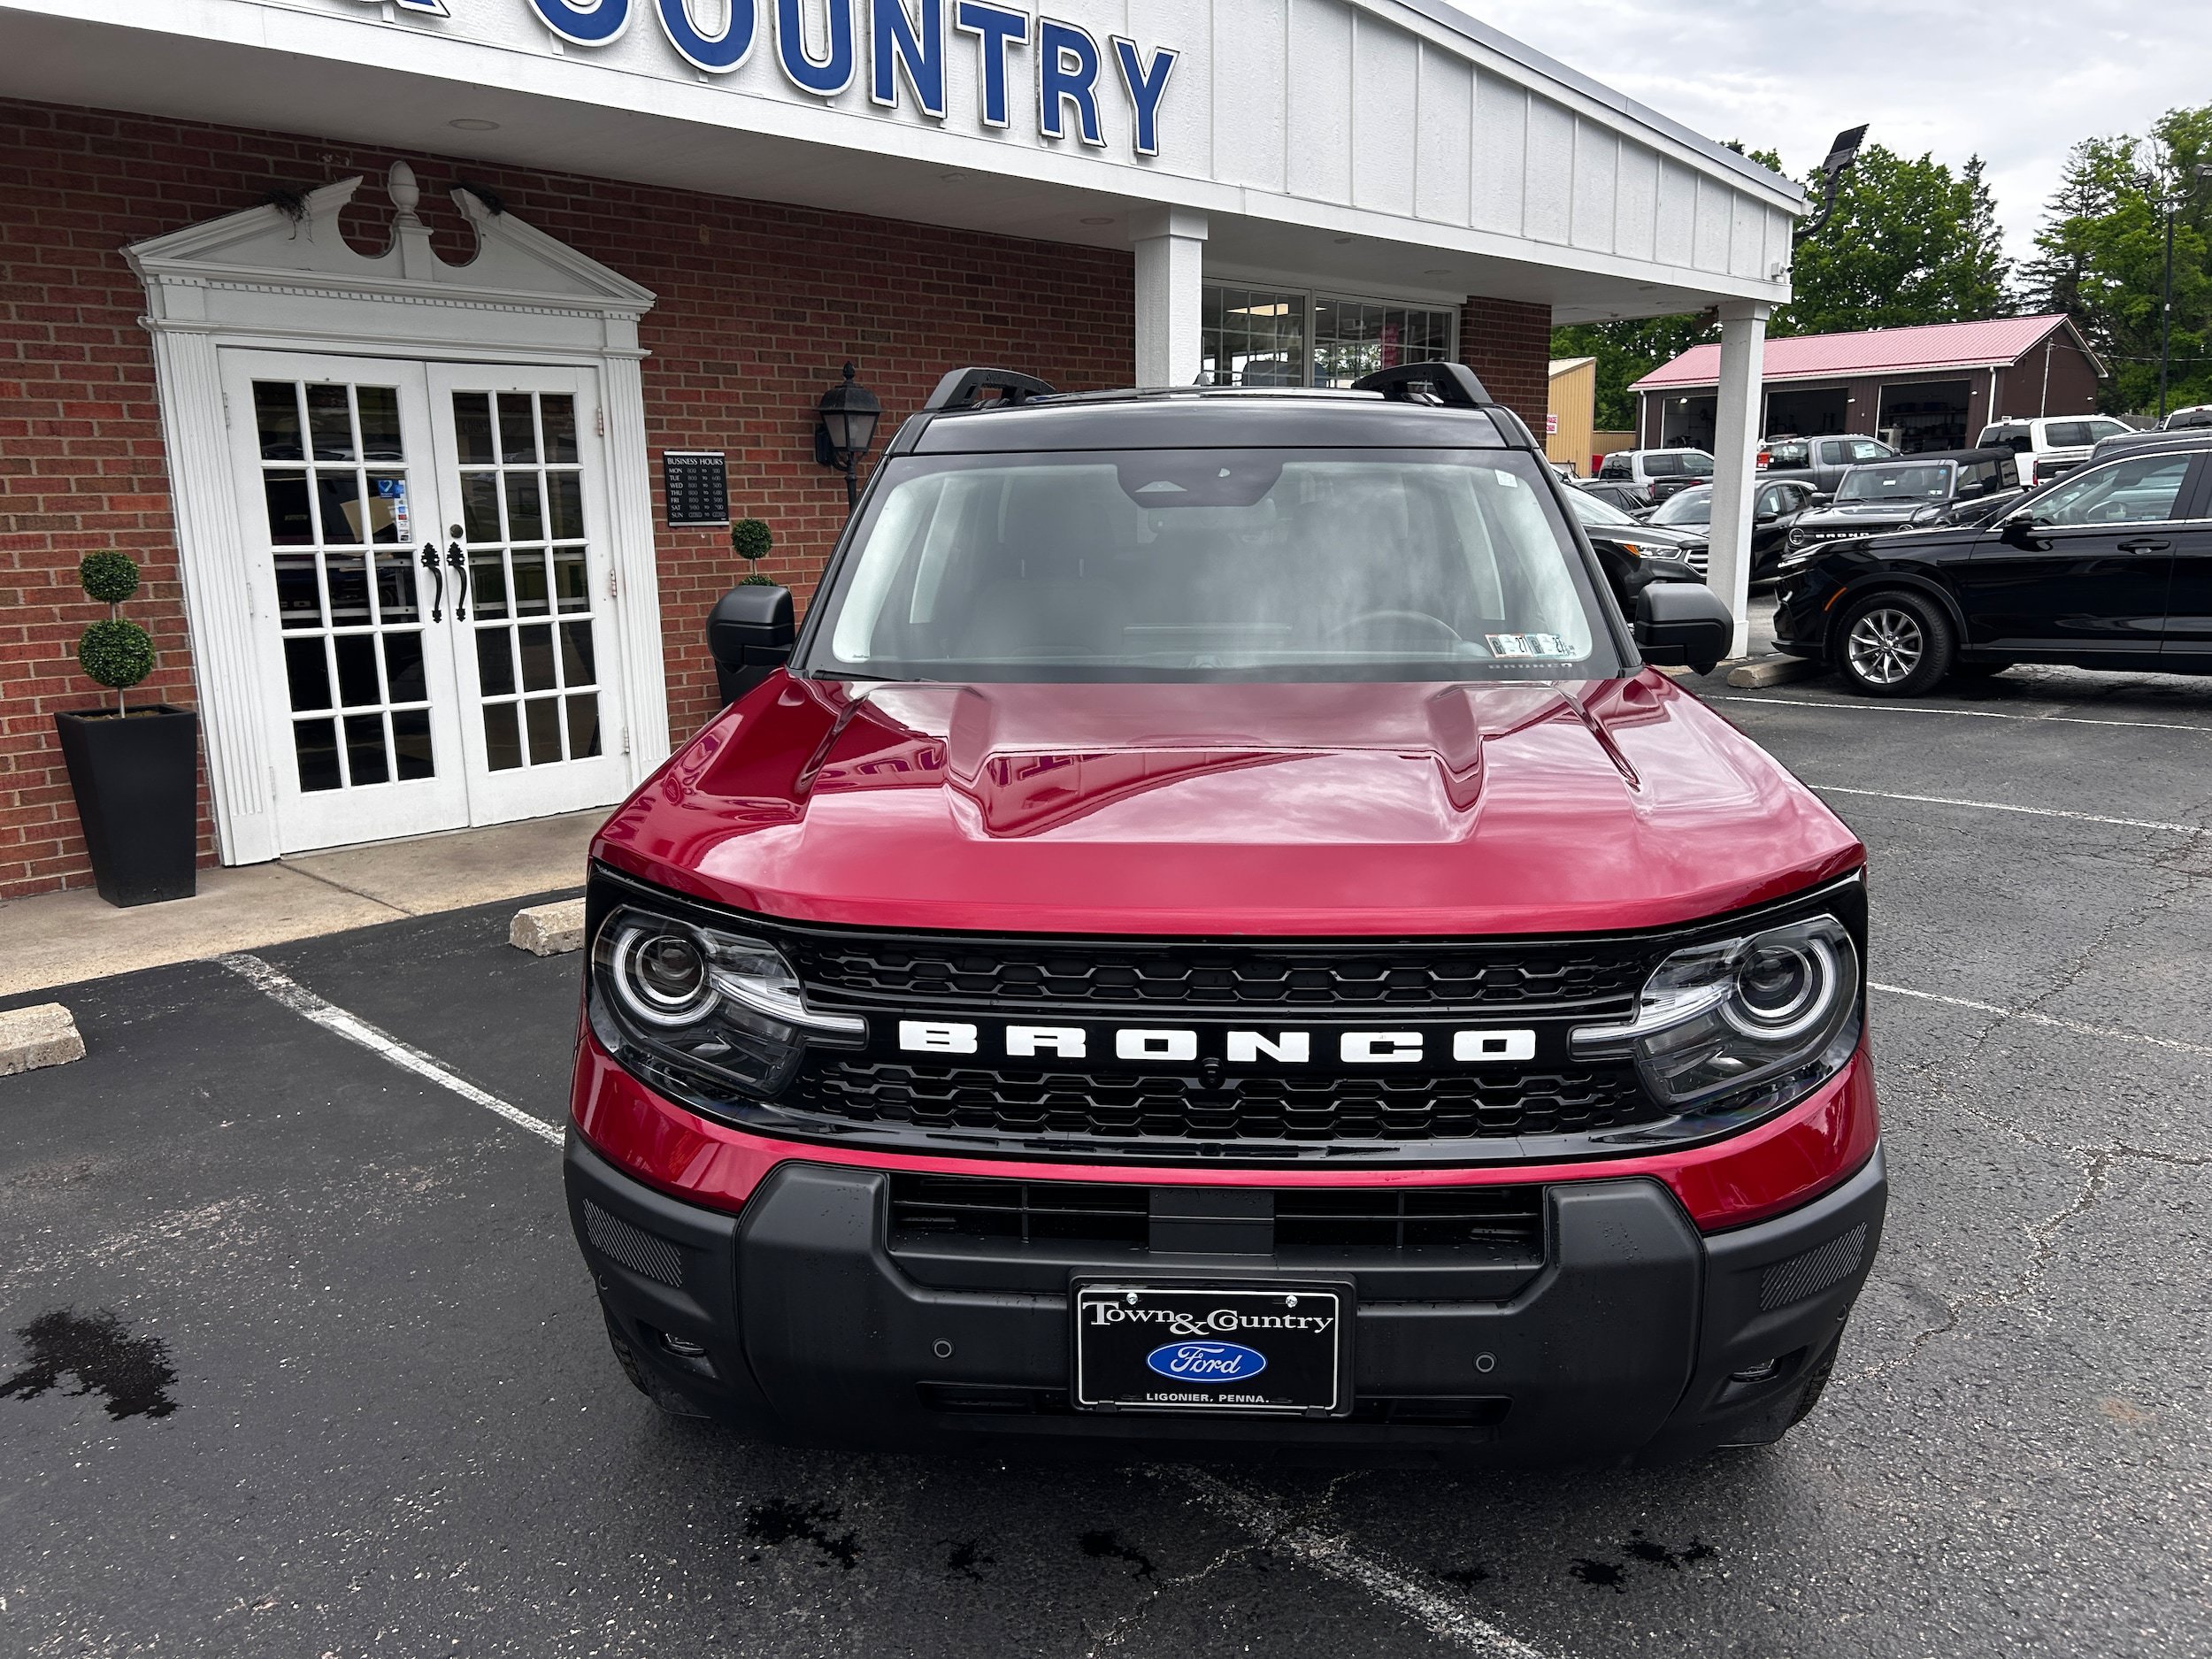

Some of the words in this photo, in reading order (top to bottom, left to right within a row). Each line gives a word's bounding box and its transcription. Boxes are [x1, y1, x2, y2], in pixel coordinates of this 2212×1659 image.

[898, 1020, 1536, 1063] BRONCO
[1170, 1346, 1243, 1374] Ford
[1146, 1392, 1214, 1402] LIGONIER,
[1218, 1394, 1270, 1403] PENNA.
